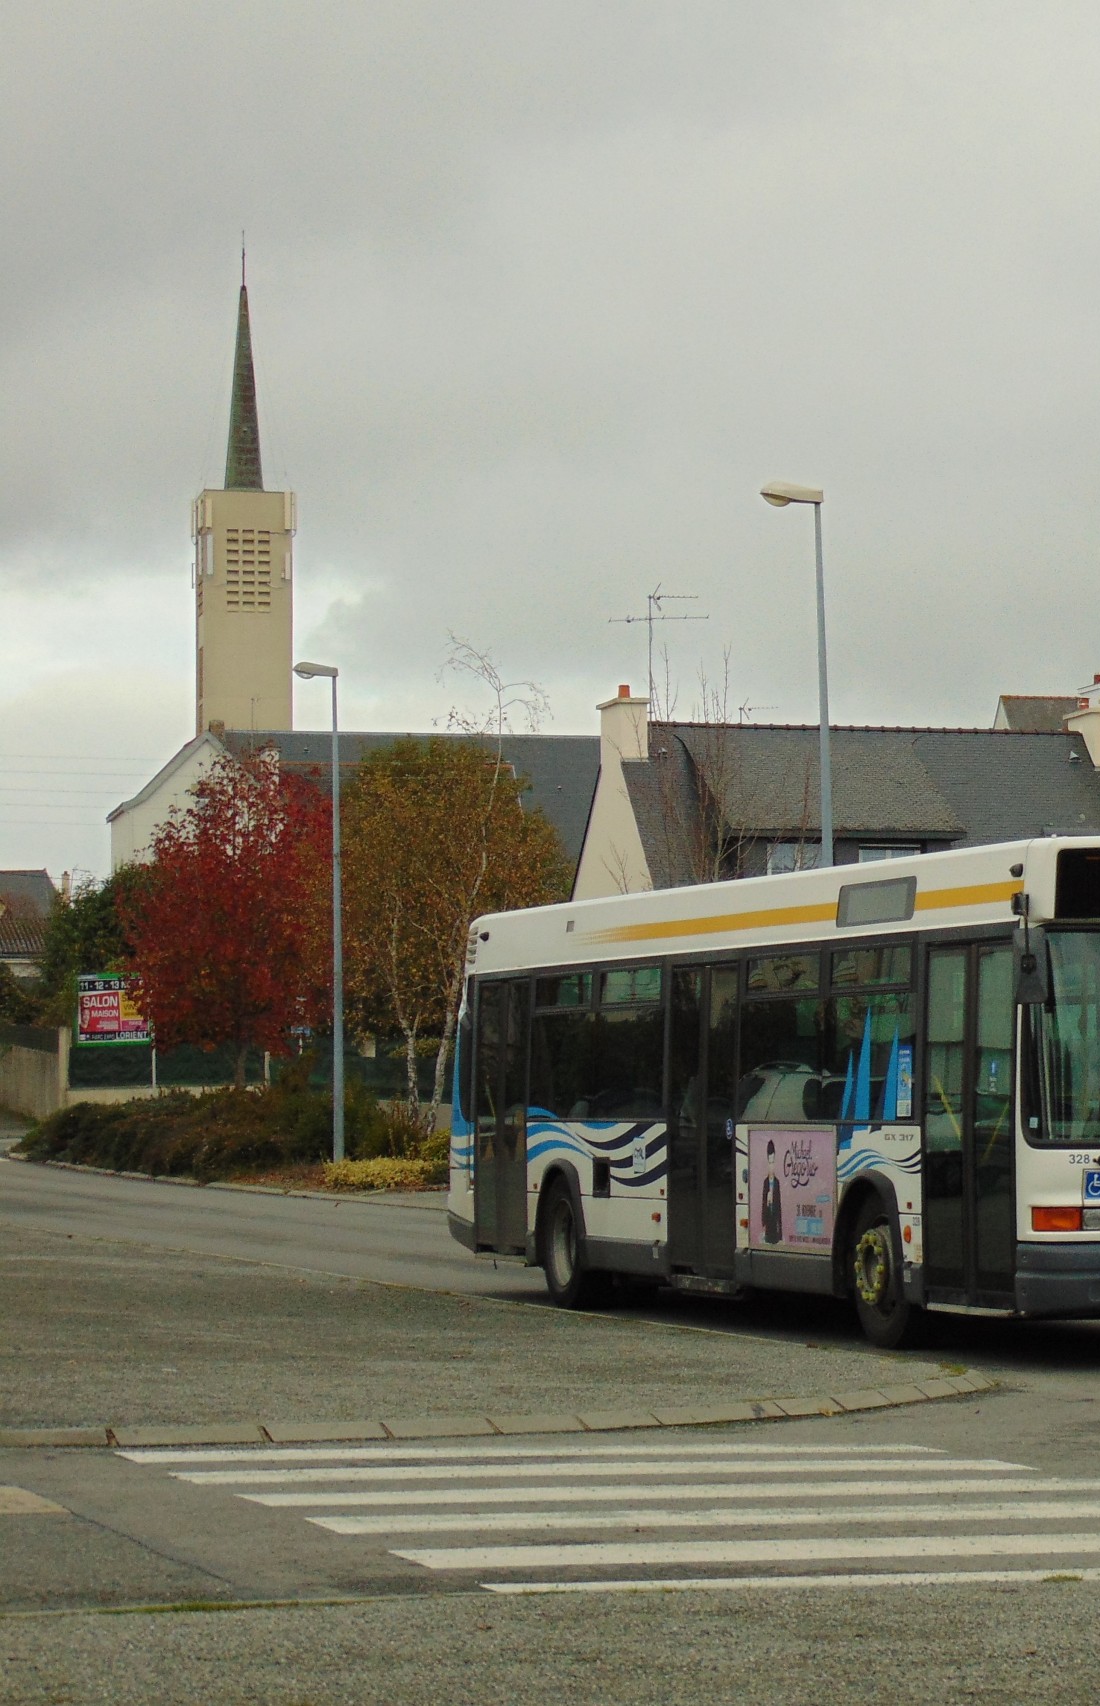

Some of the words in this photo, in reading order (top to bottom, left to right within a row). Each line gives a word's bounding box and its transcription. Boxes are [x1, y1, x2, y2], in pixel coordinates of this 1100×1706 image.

[80, 982, 88, 990] 11
[94, 981, 104, 990] 12
[111, 981, 119, 989] 13
[83, 996, 118, 1008] SALON
[92, 1010, 119, 1018] MAISON
[115, 1031, 148, 1040] LORIENT
[884, 1133, 896, 1142] GX
[899, 1133, 914, 1142] 317
[1068, 1154, 1090, 1164] 328
